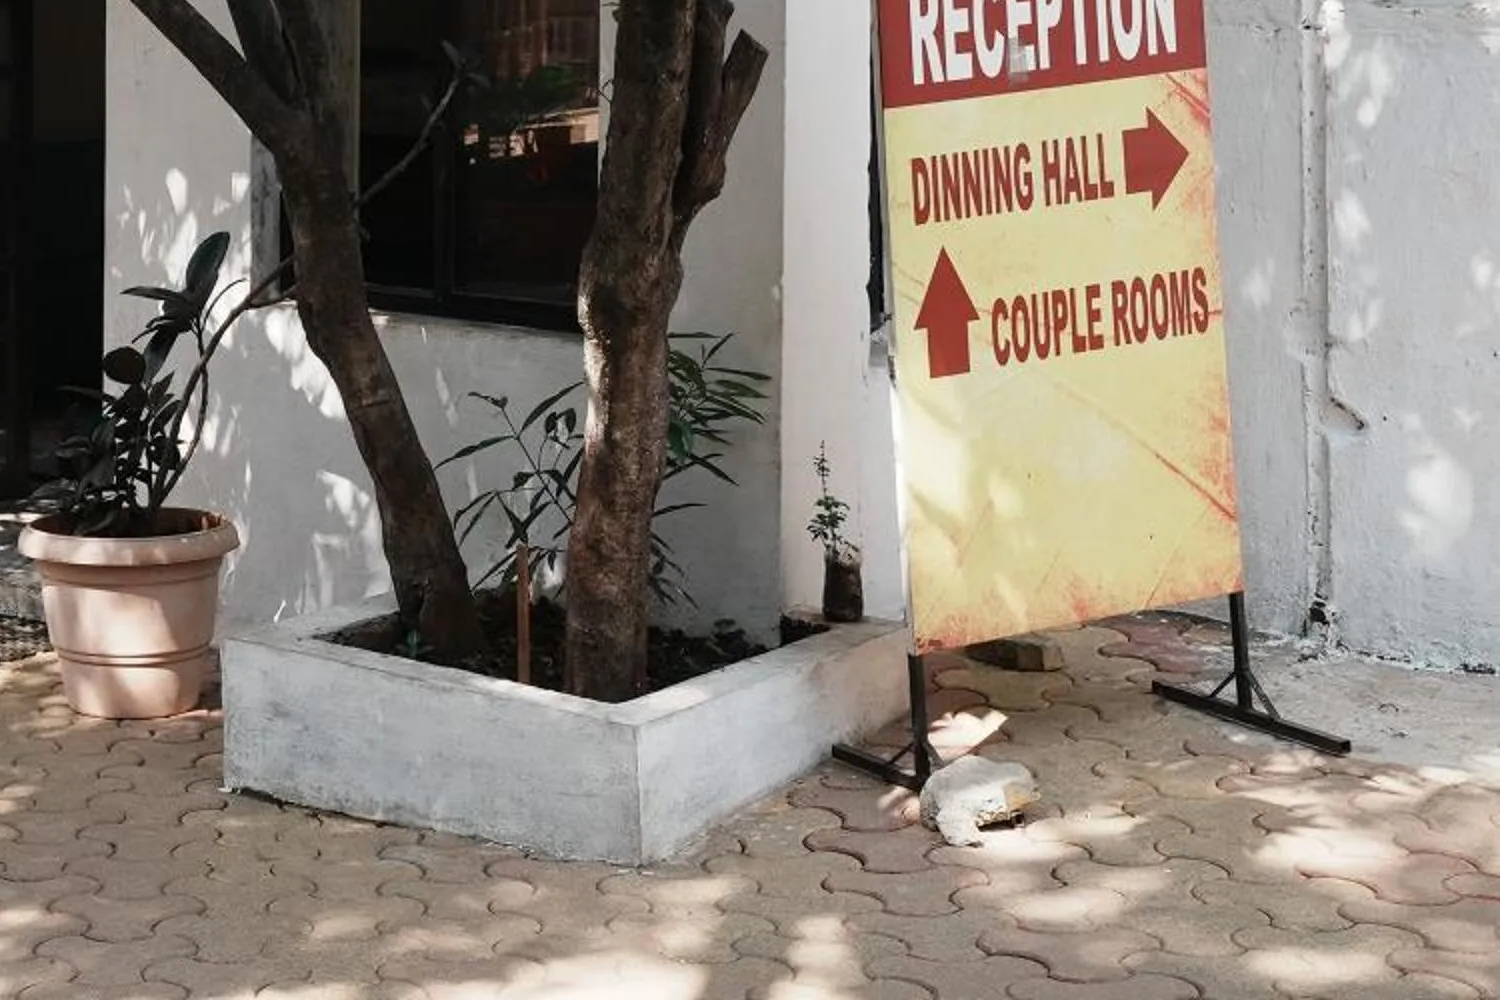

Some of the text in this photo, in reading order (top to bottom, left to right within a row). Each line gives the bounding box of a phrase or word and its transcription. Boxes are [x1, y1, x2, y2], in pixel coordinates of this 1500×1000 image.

[910, 132, 1115, 226] DINNING HALL
[991, 265, 1209, 367] COUPLE ROOMS
